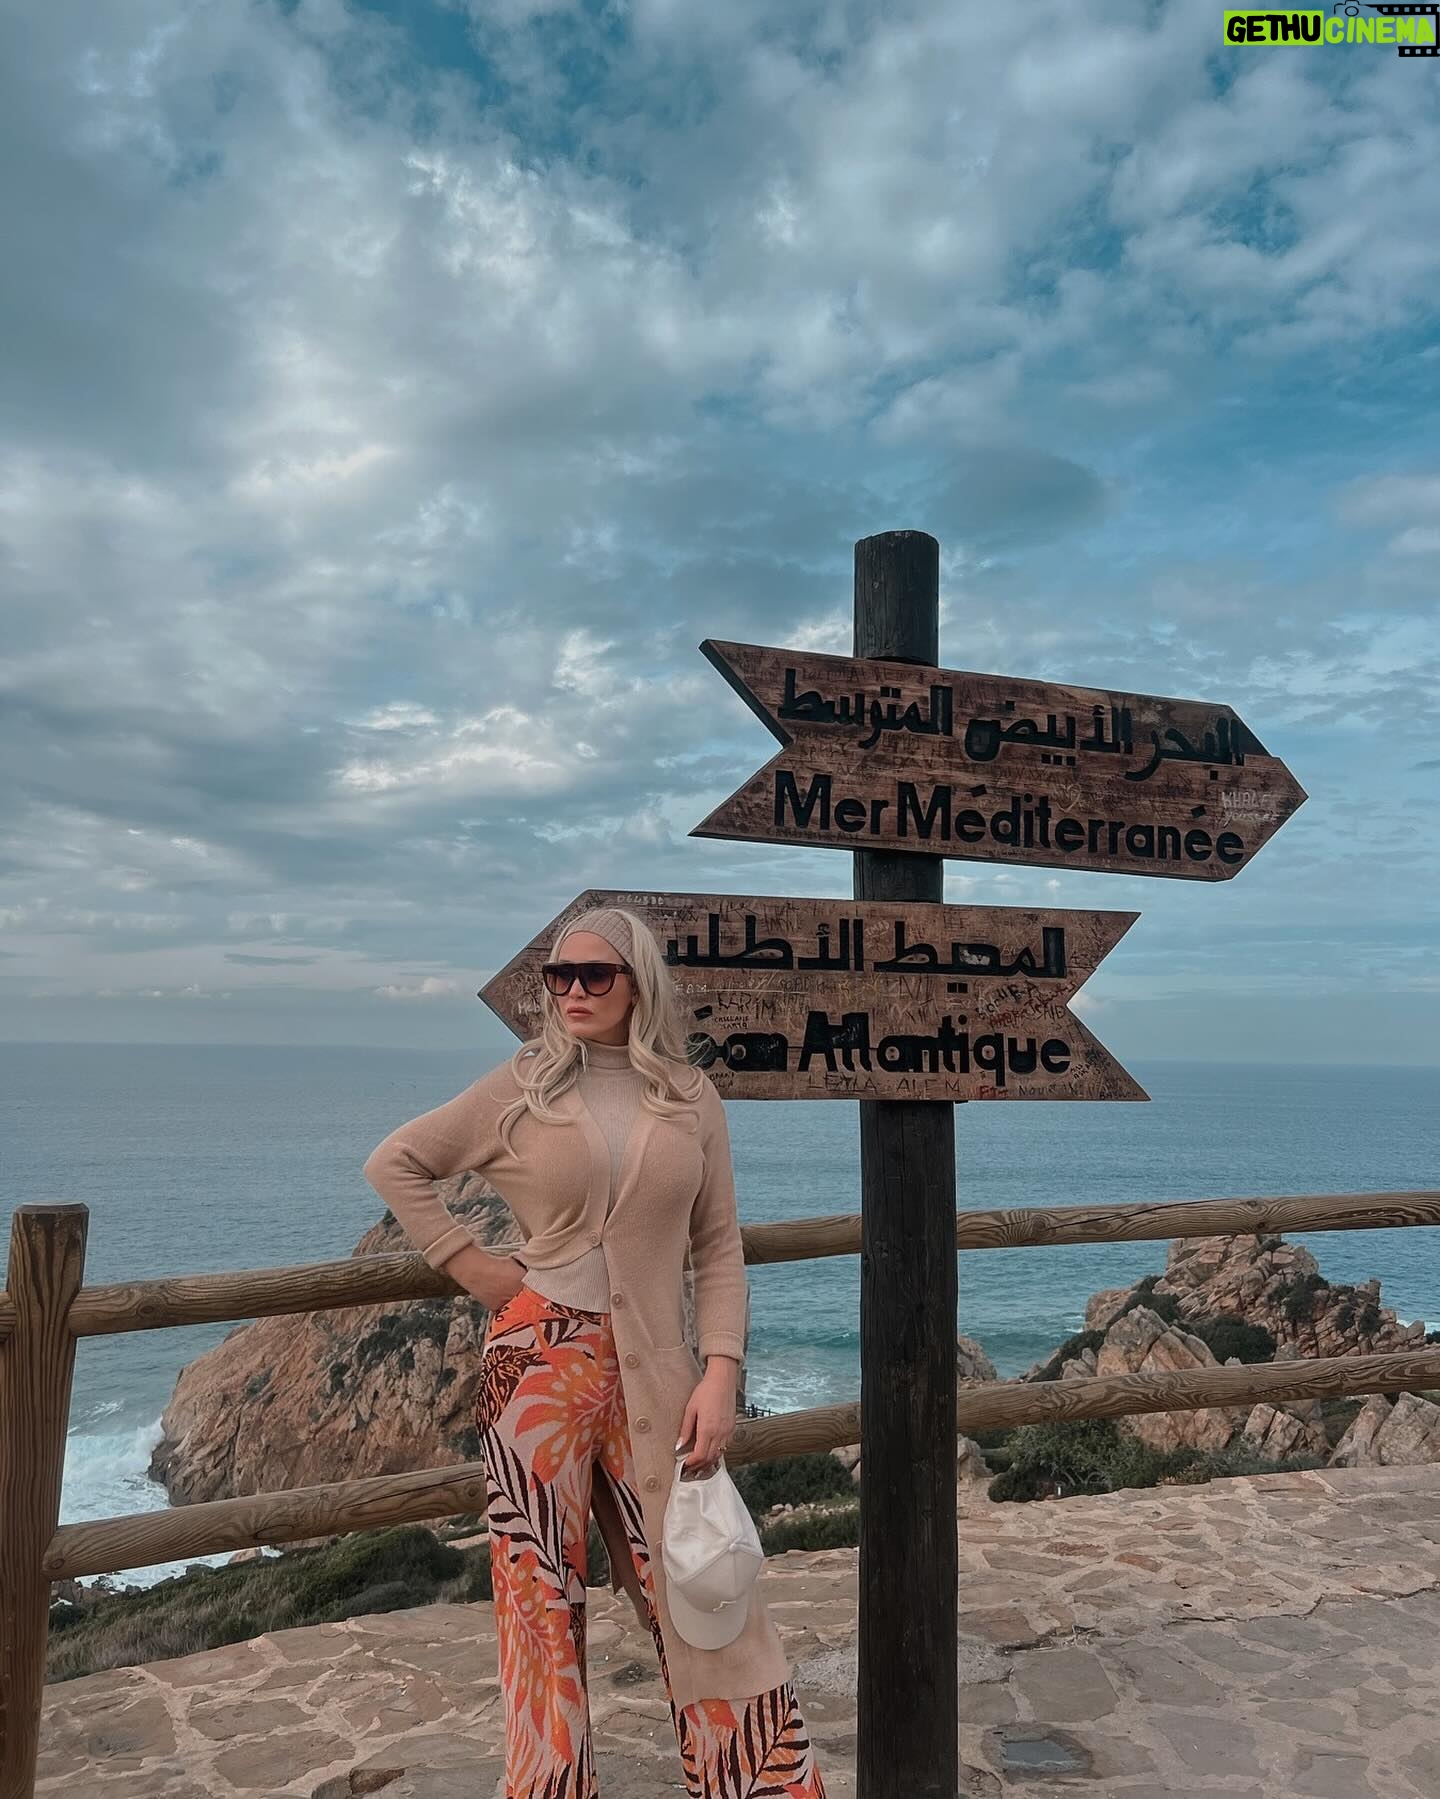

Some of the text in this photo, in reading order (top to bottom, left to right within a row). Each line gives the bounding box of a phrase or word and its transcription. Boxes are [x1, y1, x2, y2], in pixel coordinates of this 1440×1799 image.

[774, 770, 1245, 865] Mer Méditerranée
[797, 1010, 1071, 1087] Atlantique
